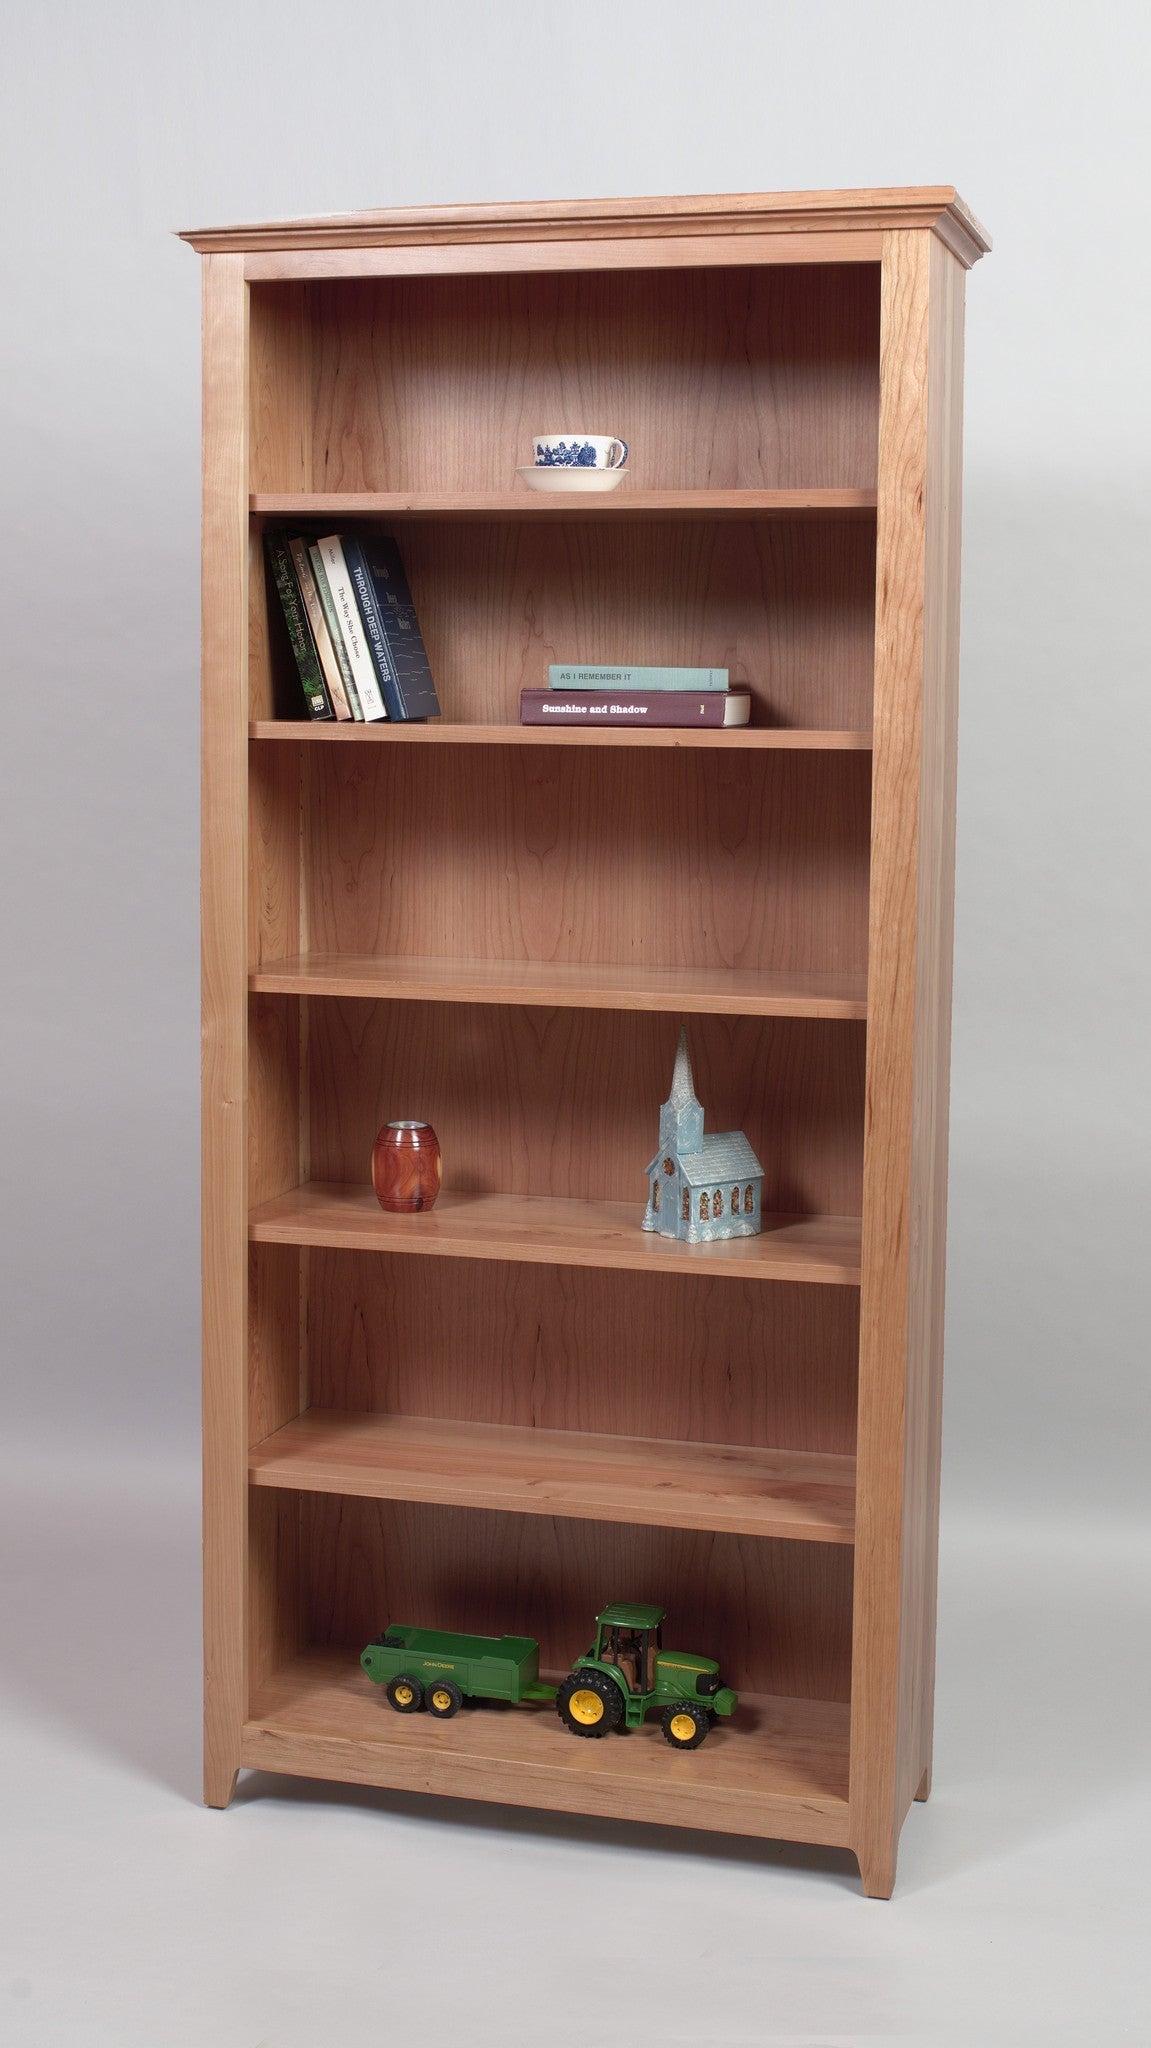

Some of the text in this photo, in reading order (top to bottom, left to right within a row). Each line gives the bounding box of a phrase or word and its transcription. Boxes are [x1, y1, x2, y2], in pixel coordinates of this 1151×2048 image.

[328, 547, 336, 565] Miller
[276, 550, 307, 652] A Song For Your Honor
[342, 602, 350, 619] Way
[351, 634, 361, 659] Chose
[353, 566, 391, 682] THROUGH DEEP WATERS
[578, 672, 622, 681] REMEMBER
[624, 673, 632, 681] IT
[542, 704, 649, 715] Sunshine and Shadow
